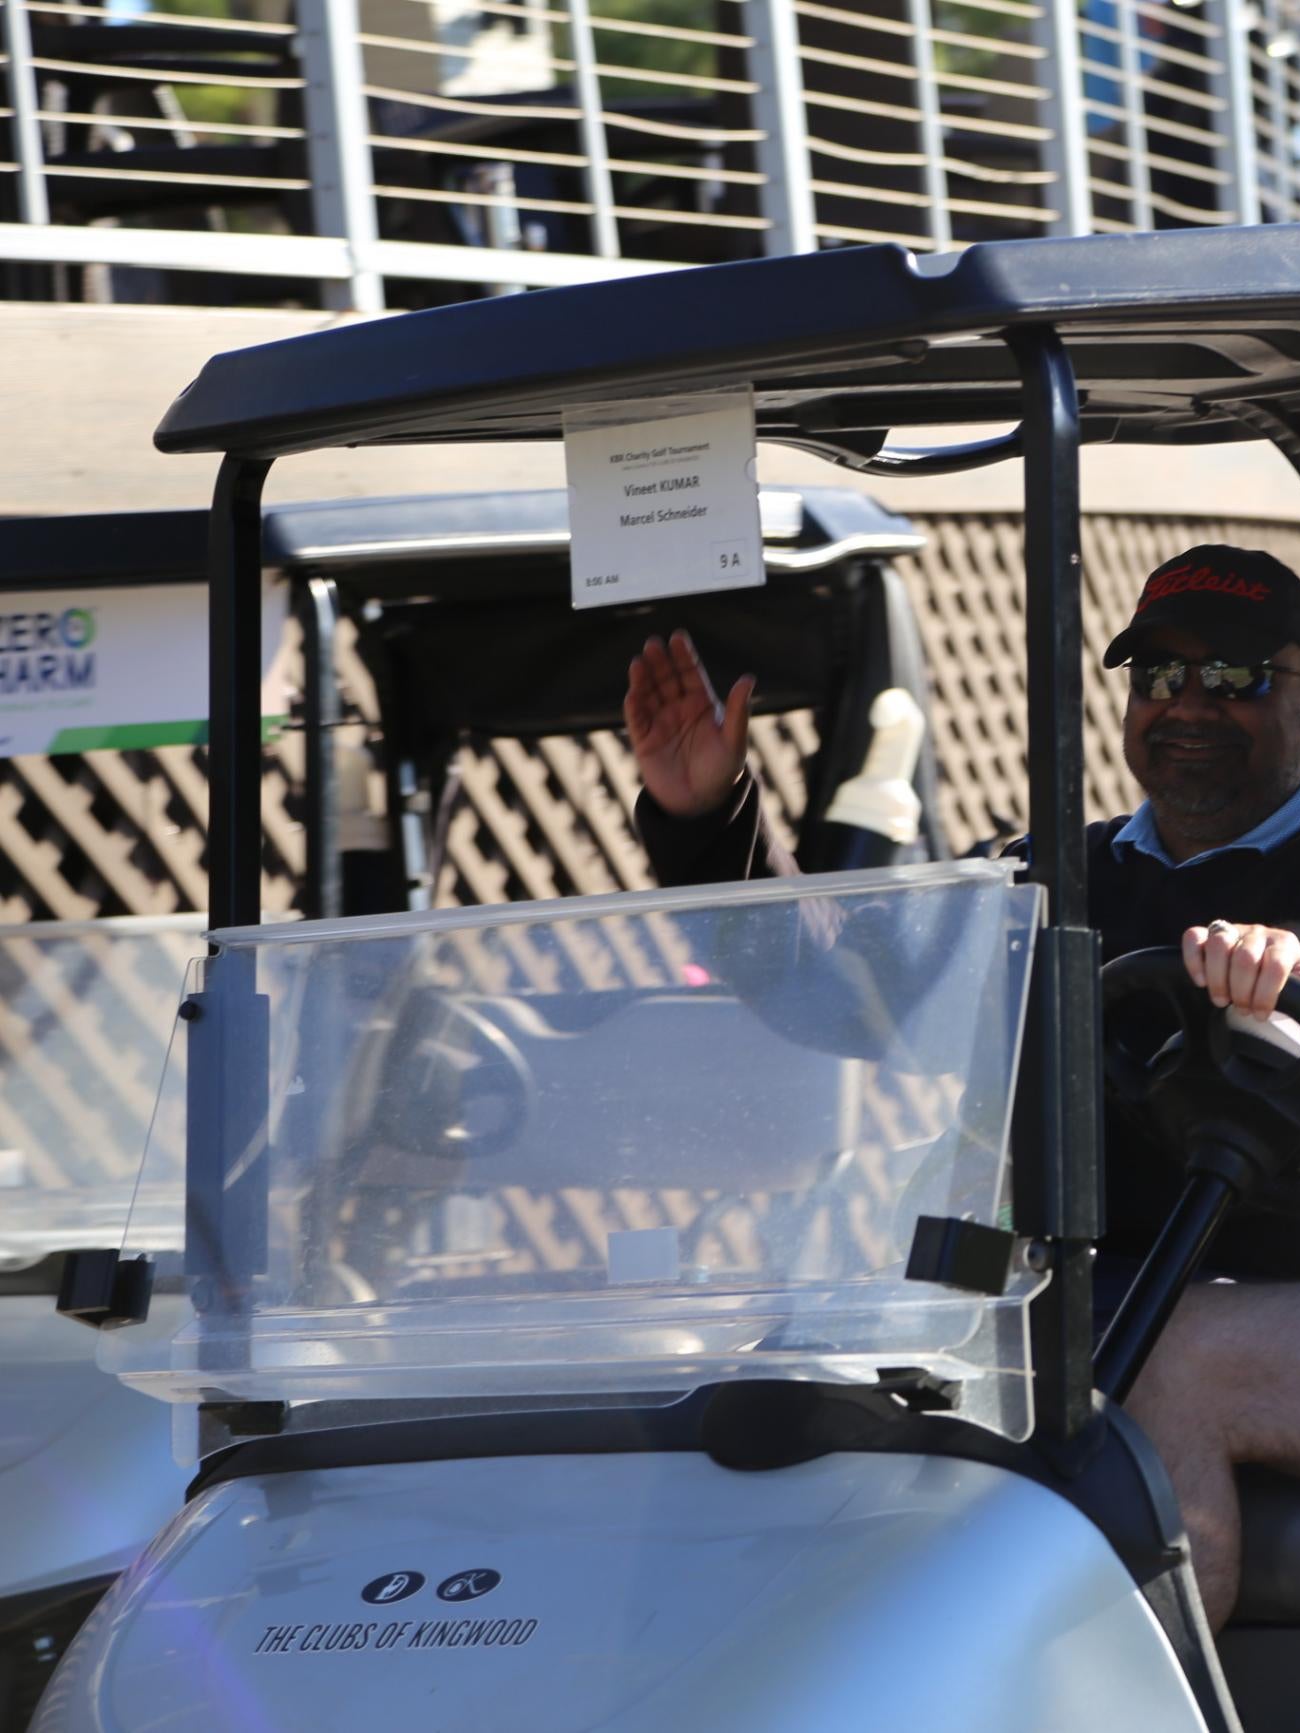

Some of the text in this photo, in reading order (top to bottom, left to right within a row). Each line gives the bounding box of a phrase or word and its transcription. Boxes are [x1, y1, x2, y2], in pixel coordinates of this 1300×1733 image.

[625, 452, 650, 462] Charity
[651, 448, 667, 458] Golf
[668, 442, 710, 455] Tournament
[624, 475, 700, 496] Vineet KUMAR
[620, 506, 707, 527] Marcel Schneider
[720, 553, 740, 568] 9 A
[604, 574, 619, 584] AM
[254, 1619, 538, 1653] THE CLUBS OF KINGWOOD
